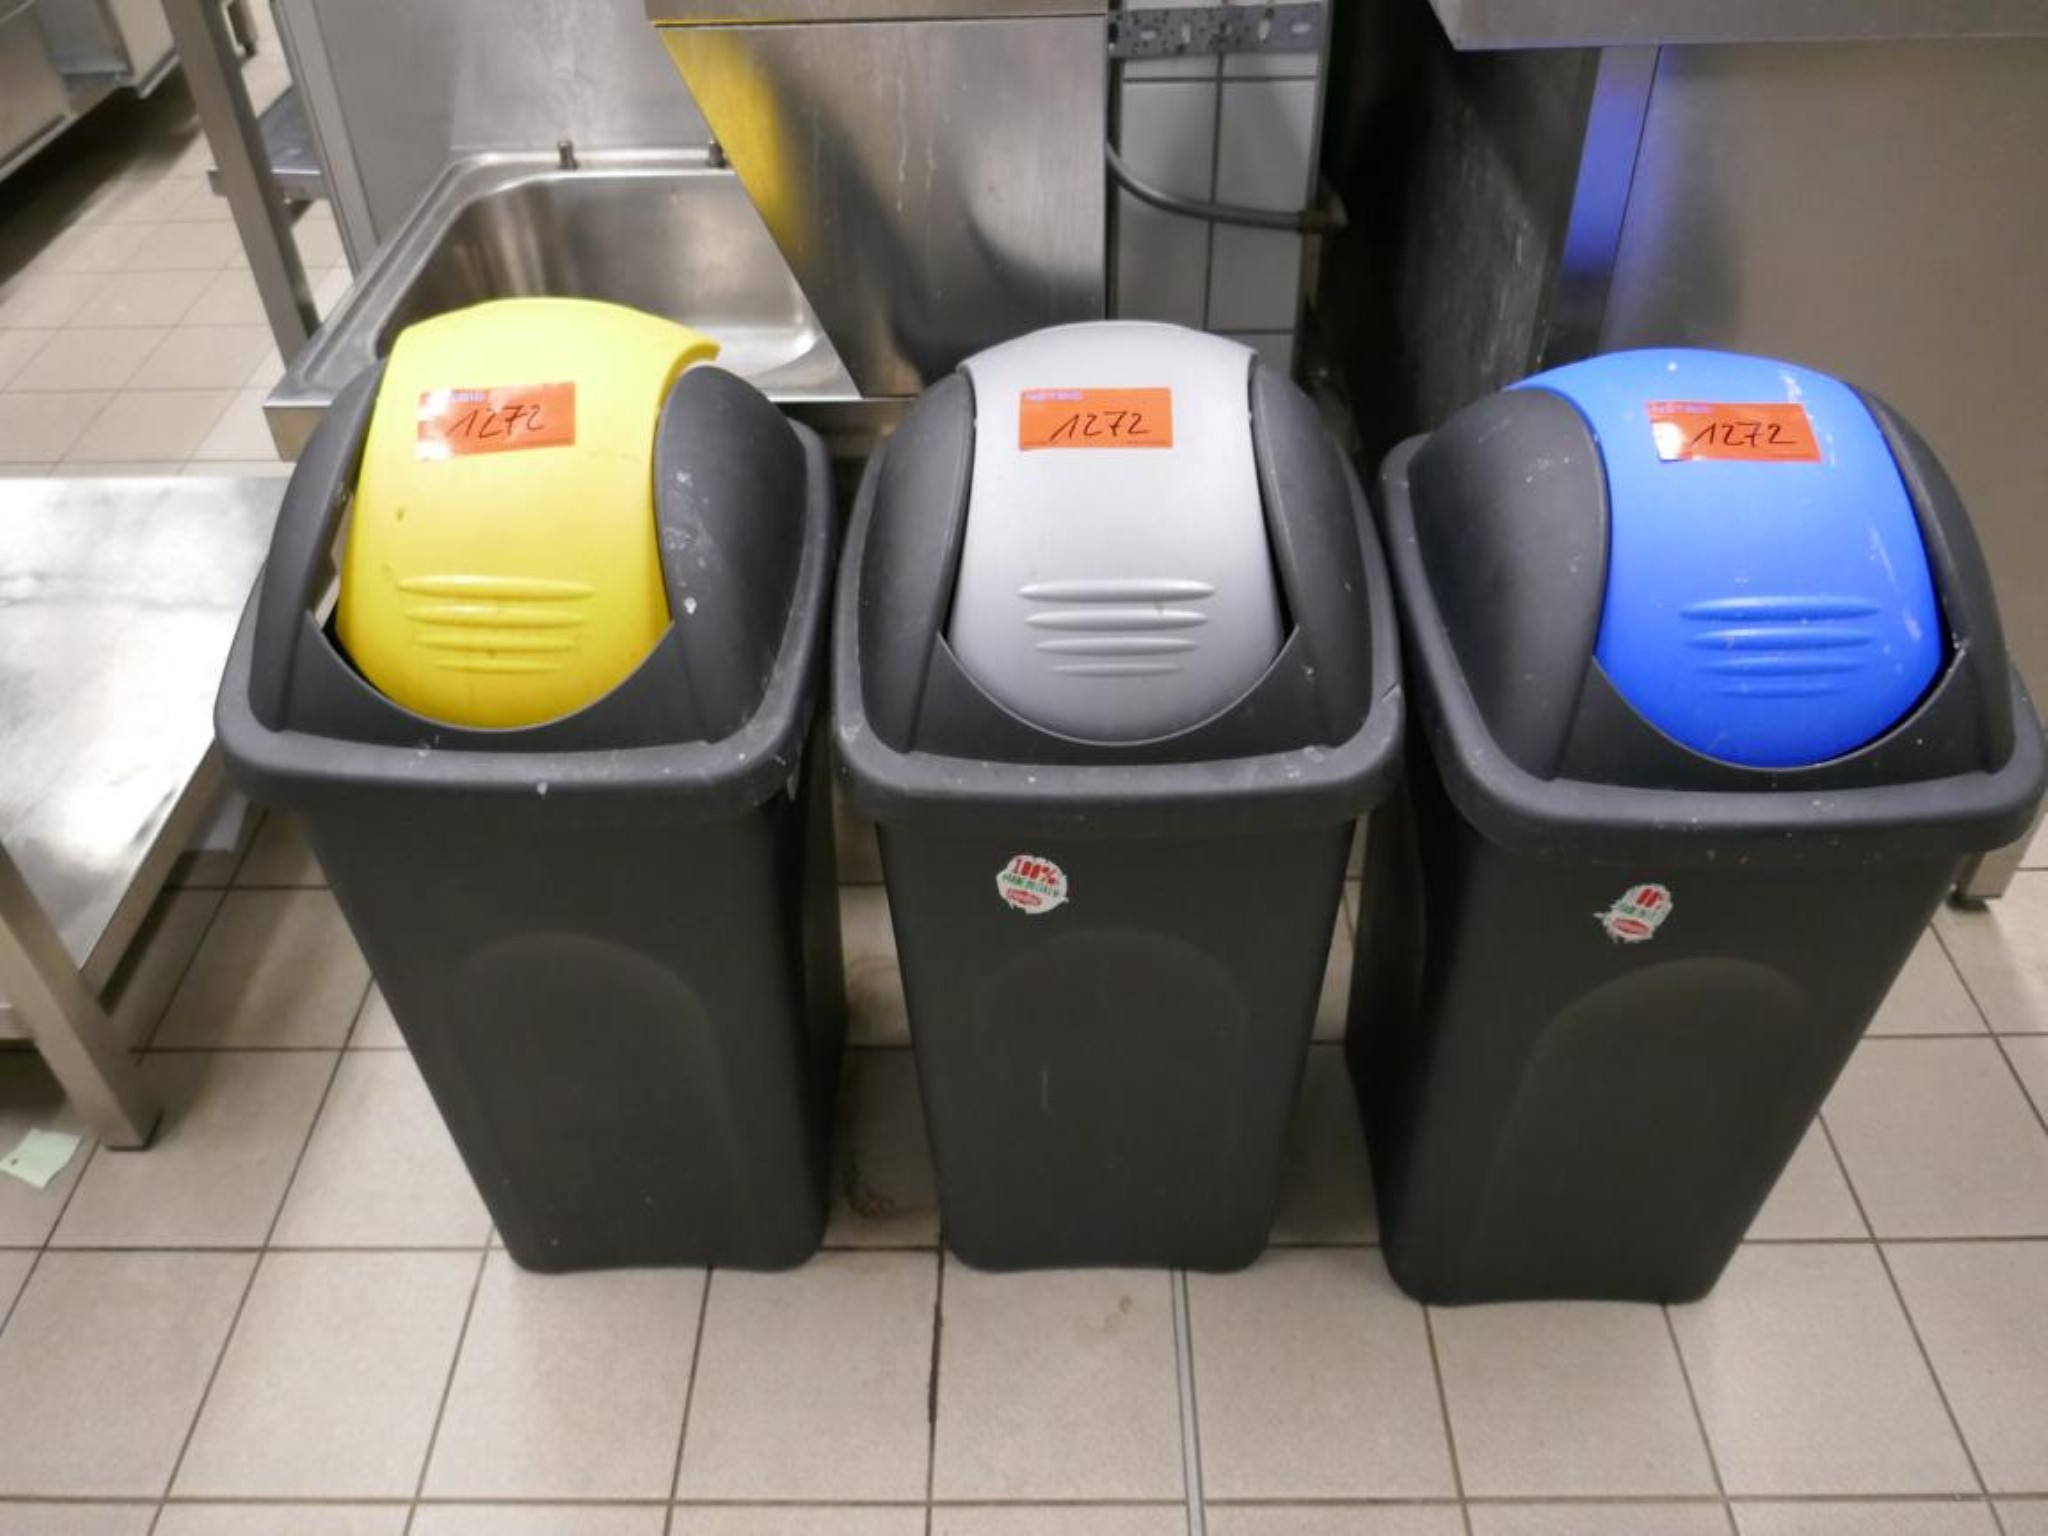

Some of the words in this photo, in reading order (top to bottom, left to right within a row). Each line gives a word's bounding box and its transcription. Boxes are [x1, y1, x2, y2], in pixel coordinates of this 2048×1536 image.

[445, 404, 545, 440] 1272
[1048, 410, 1151, 442] 1272
[1688, 421, 1796, 448] 1272
